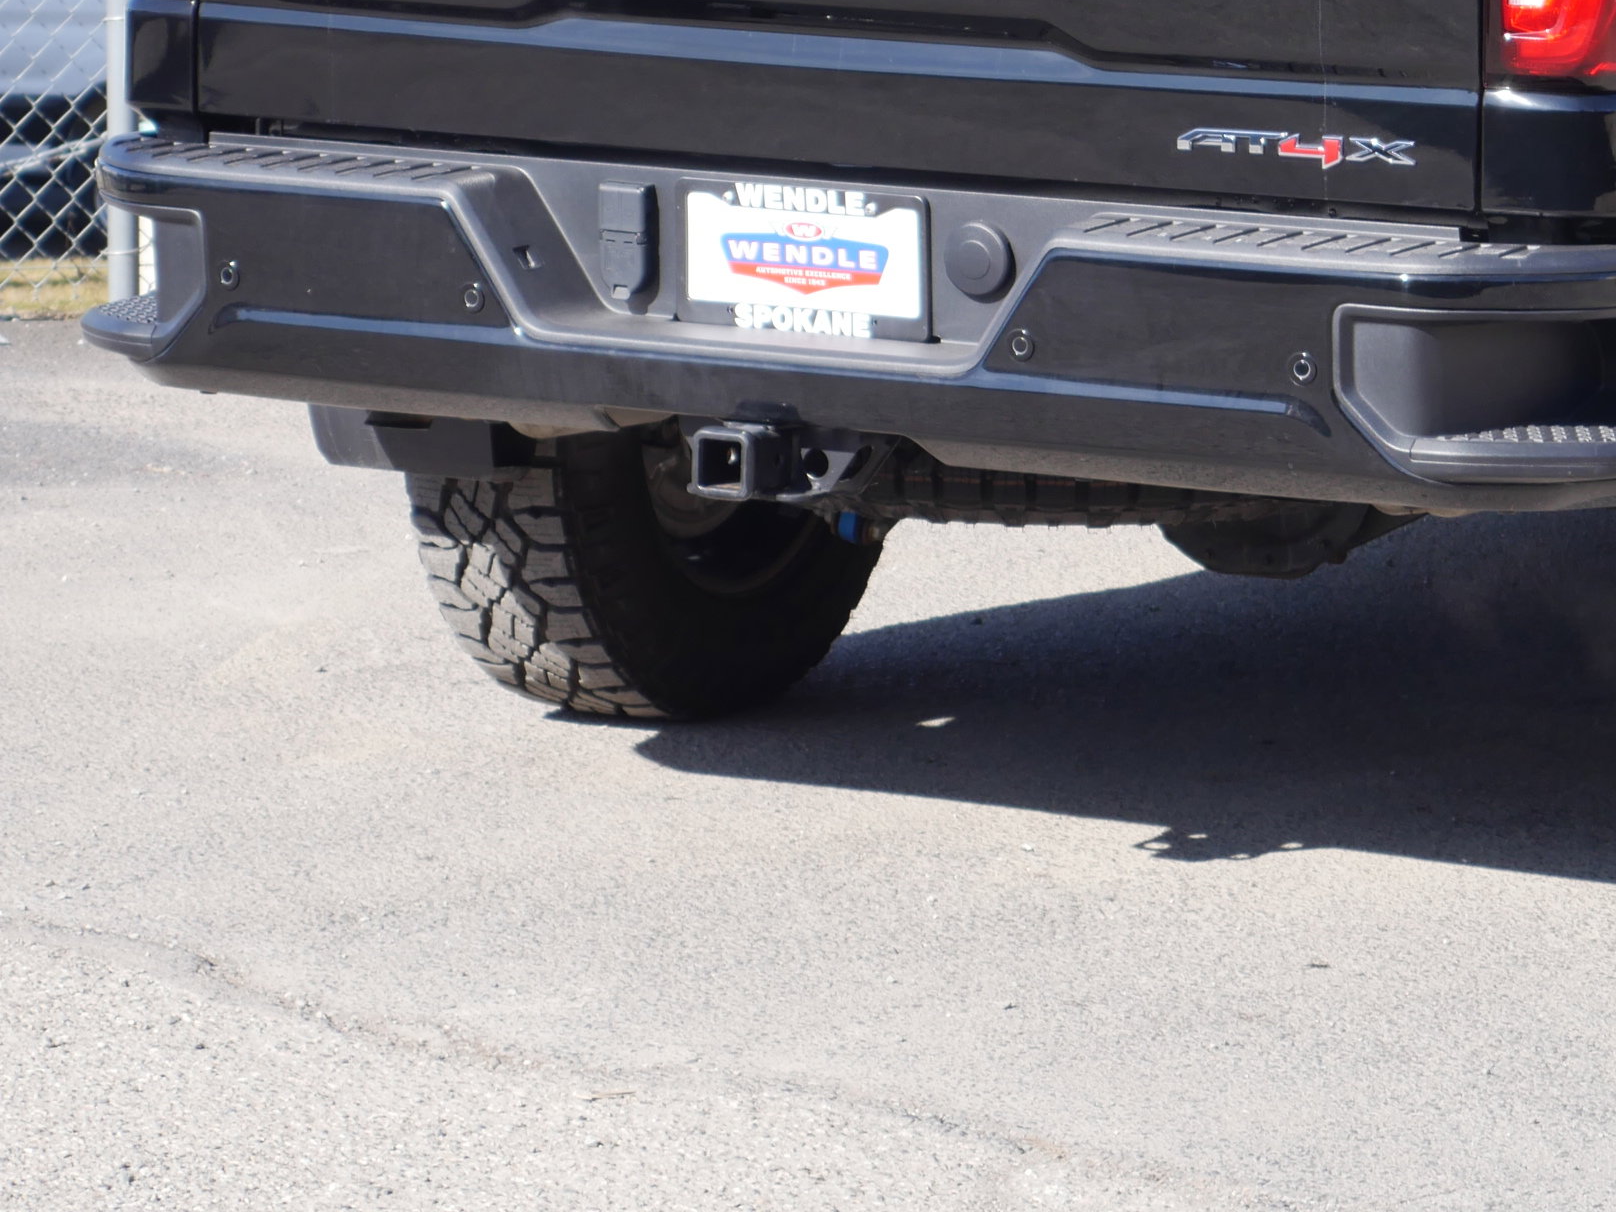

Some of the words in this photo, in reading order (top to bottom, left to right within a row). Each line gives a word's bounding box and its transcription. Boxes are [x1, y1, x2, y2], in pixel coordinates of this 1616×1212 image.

[1177, 128, 1416, 169] AT4X
[734, 182, 866, 217] WENDLE
[791, 223, 817, 239] W
[727, 238, 878, 270] WENDLE
[755, 265, 804, 277] AUTOMOTIVE
[805, 269, 852, 281] EXCELLENCE
[784, 276, 807, 285] SINCE
[734, 302, 872, 338] SPOKANE
